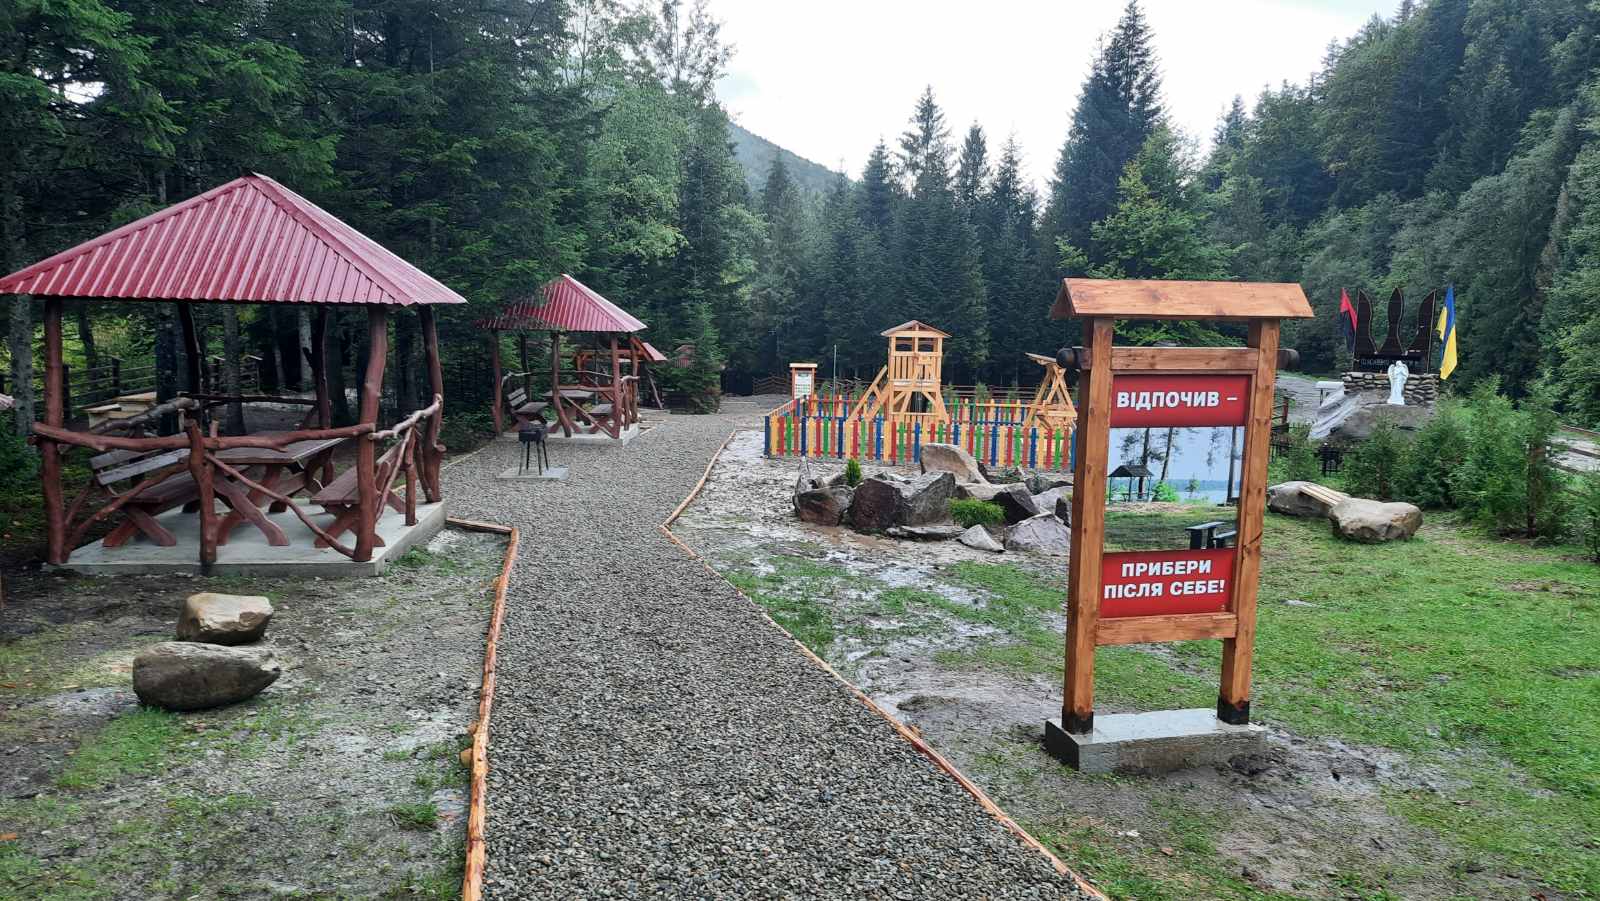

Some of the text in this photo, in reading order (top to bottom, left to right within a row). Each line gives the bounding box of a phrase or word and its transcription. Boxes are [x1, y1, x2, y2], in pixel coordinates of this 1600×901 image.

[1116, 391, 1220, 411] ВІДПОЧИВ
[1121, 559, 1212, 577] ПРИБЕРИ
[1103, 579, 1225, 599] ПІСЛЯ СЕБЕ!
